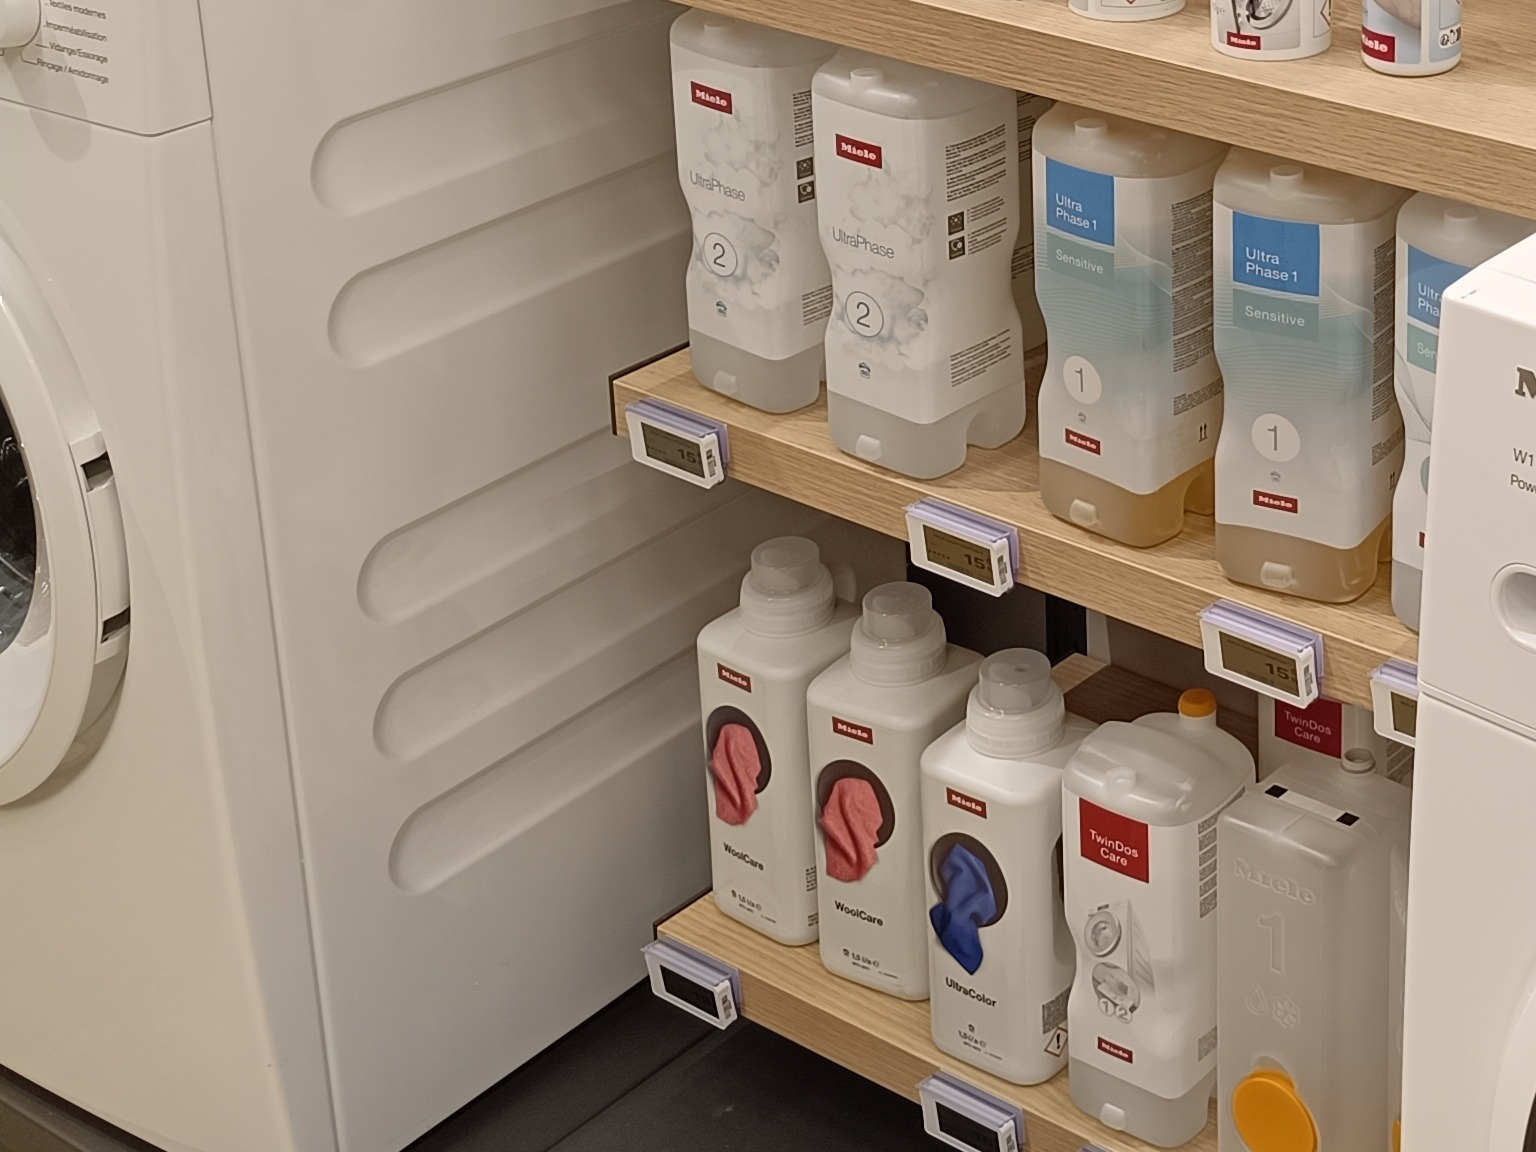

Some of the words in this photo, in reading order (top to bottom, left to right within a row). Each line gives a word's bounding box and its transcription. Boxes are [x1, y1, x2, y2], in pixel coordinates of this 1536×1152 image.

[695, 89, 728, 108] Miele
[841, 142, 877, 162] Miele
[690, 170, 746, 202] UltraPhase
[1055, 192, 1082, 213] Ultra
[1056, 207, 1090, 229] Phase
[1092, 219, 1097, 231] 1
[712, 242, 726, 268] 2
[833, 227, 894, 259] UltraPhase
[1056, 248, 1103, 275] Sensitive
[1245, 247, 1280, 265] Ultra
[1245, 261, 1288, 281] Phase
[1291, 270, 1298, 283] 1
[856, 301, 871, 328] 2
[1244, 305, 1305, 327] Sensitive
[1075, 367, 1084, 393] 1
[1069, 432, 1097, 449] Miele
[1267, 425, 1278, 451] 1
[1513, 448, 1533, 467] W1
[1258, 495, 1293, 509] Miele
[720, 667, 748, 688] Miele
[837, 720, 869, 739] Miele
[1284, 710, 1331, 735] TwinDos
[1294, 726, 1321, 744] Care
[951, 793, 982, 812] Miele
[1089, 829, 1138, 858] TwinDos
[723, 841, 764, 872] WoolCare
[1100, 847, 1127, 867] Care
[1233, 859, 1315, 905] Miele
[835, 899, 883, 926] WoolCare
[1258, 913, 1286, 974] 1
[945, 976, 997, 1008] UltraColor
